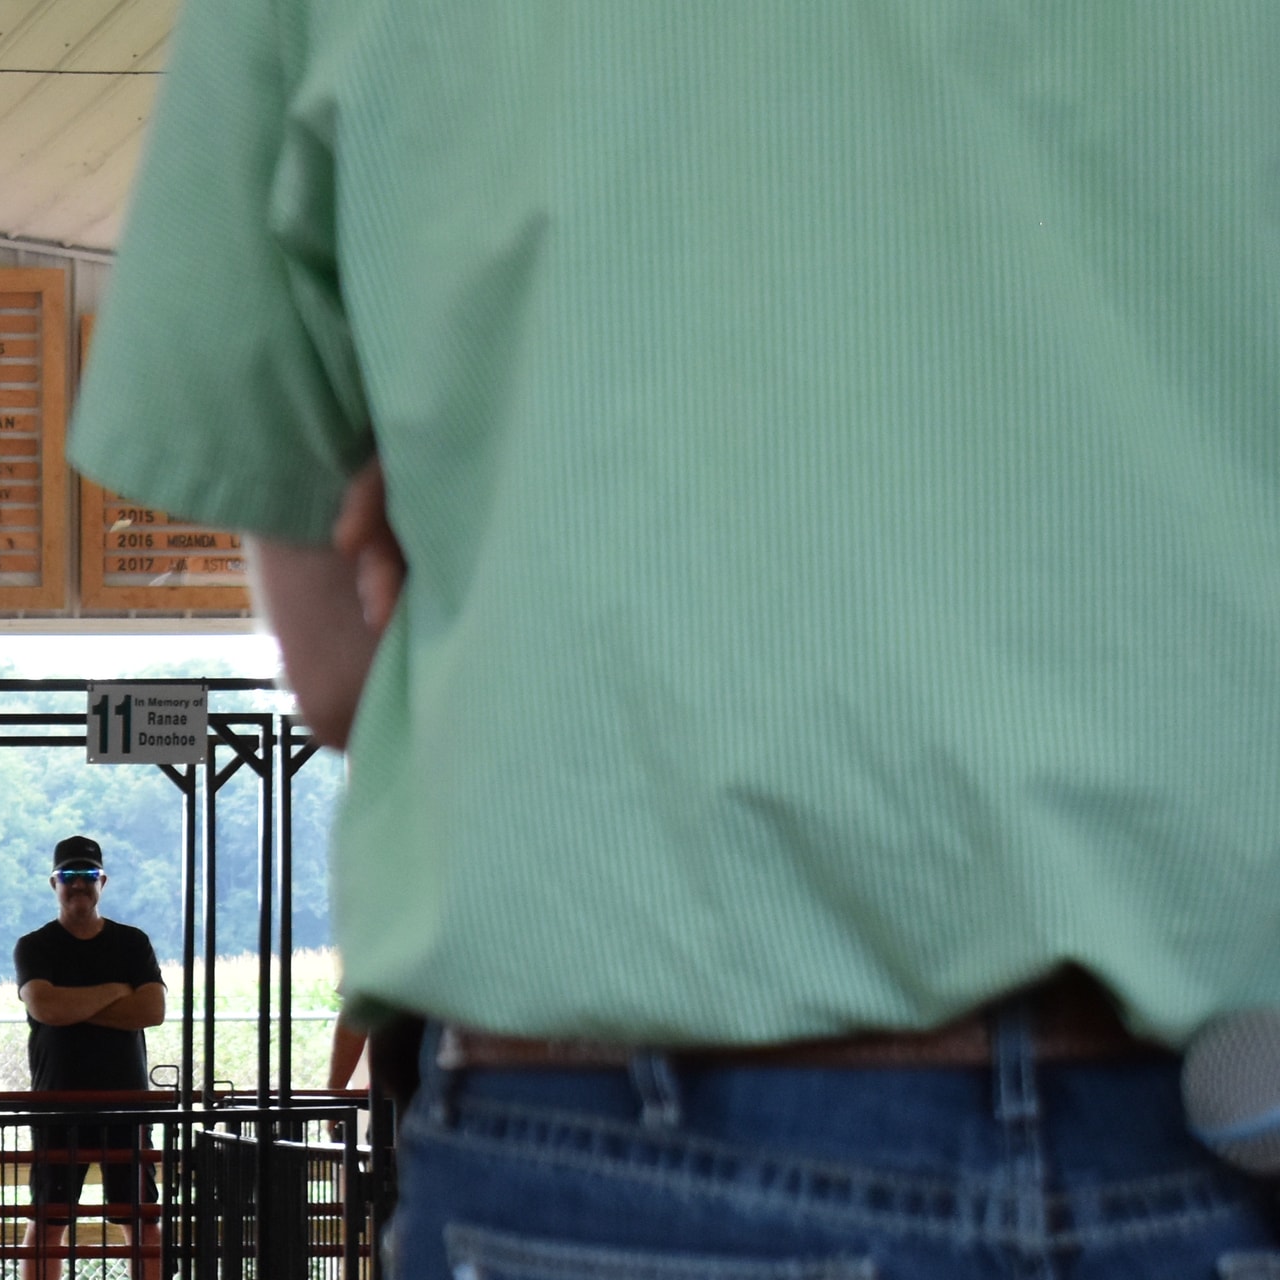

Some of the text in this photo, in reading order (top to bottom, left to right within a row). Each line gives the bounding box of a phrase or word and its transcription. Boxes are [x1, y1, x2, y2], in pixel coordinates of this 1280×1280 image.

[118, 534, 153, 547] 2016
[118, 559, 154, 571] 2017
[135, 698, 203, 708] In Memory of
[92, 695, 131, 754] 11
[148, 712, 187, 725] Ranae
[139, 732, 195, 746] Donohoe
